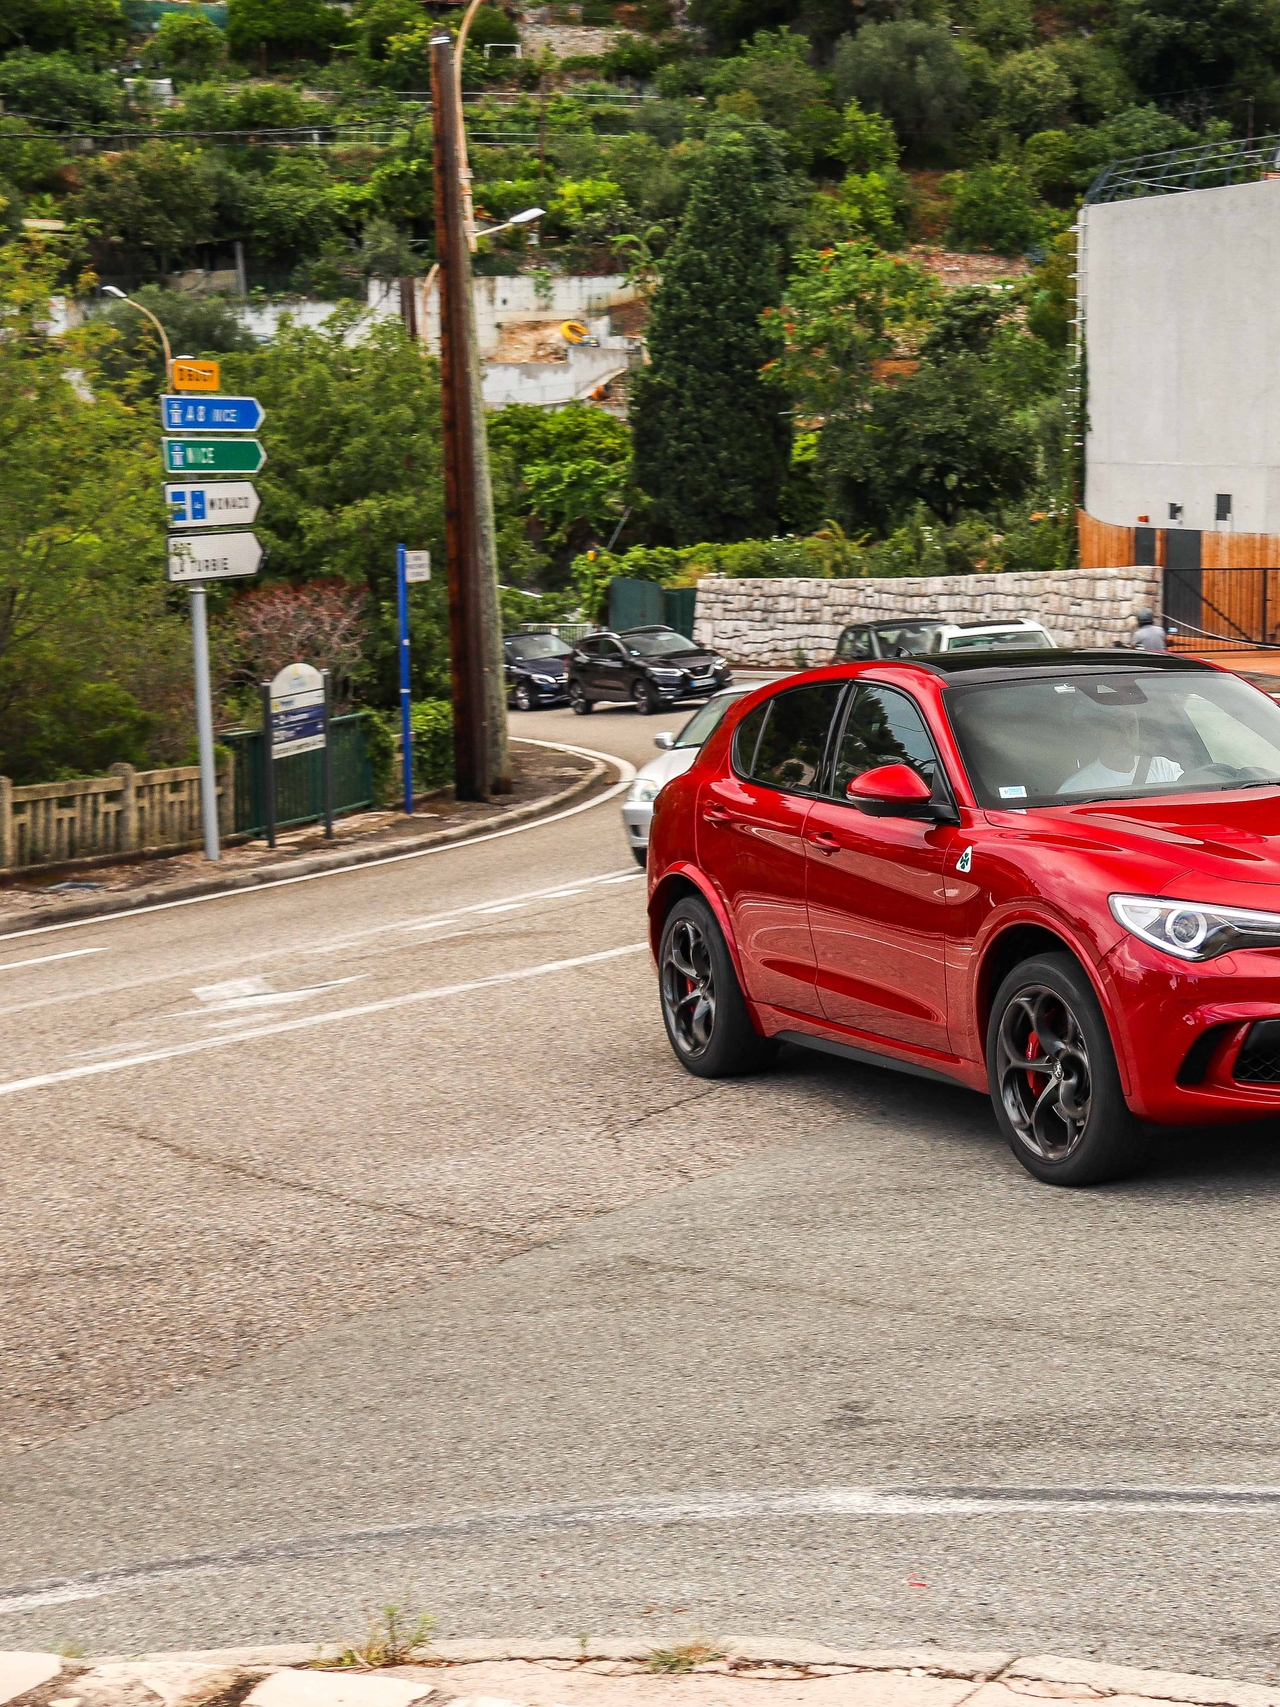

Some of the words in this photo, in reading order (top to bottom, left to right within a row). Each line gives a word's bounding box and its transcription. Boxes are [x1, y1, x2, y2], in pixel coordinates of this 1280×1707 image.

[213, 409, 238, 423] NICE
[186, 447, 215, 464] NICE
[207, 496, 249, 510] MONACO
